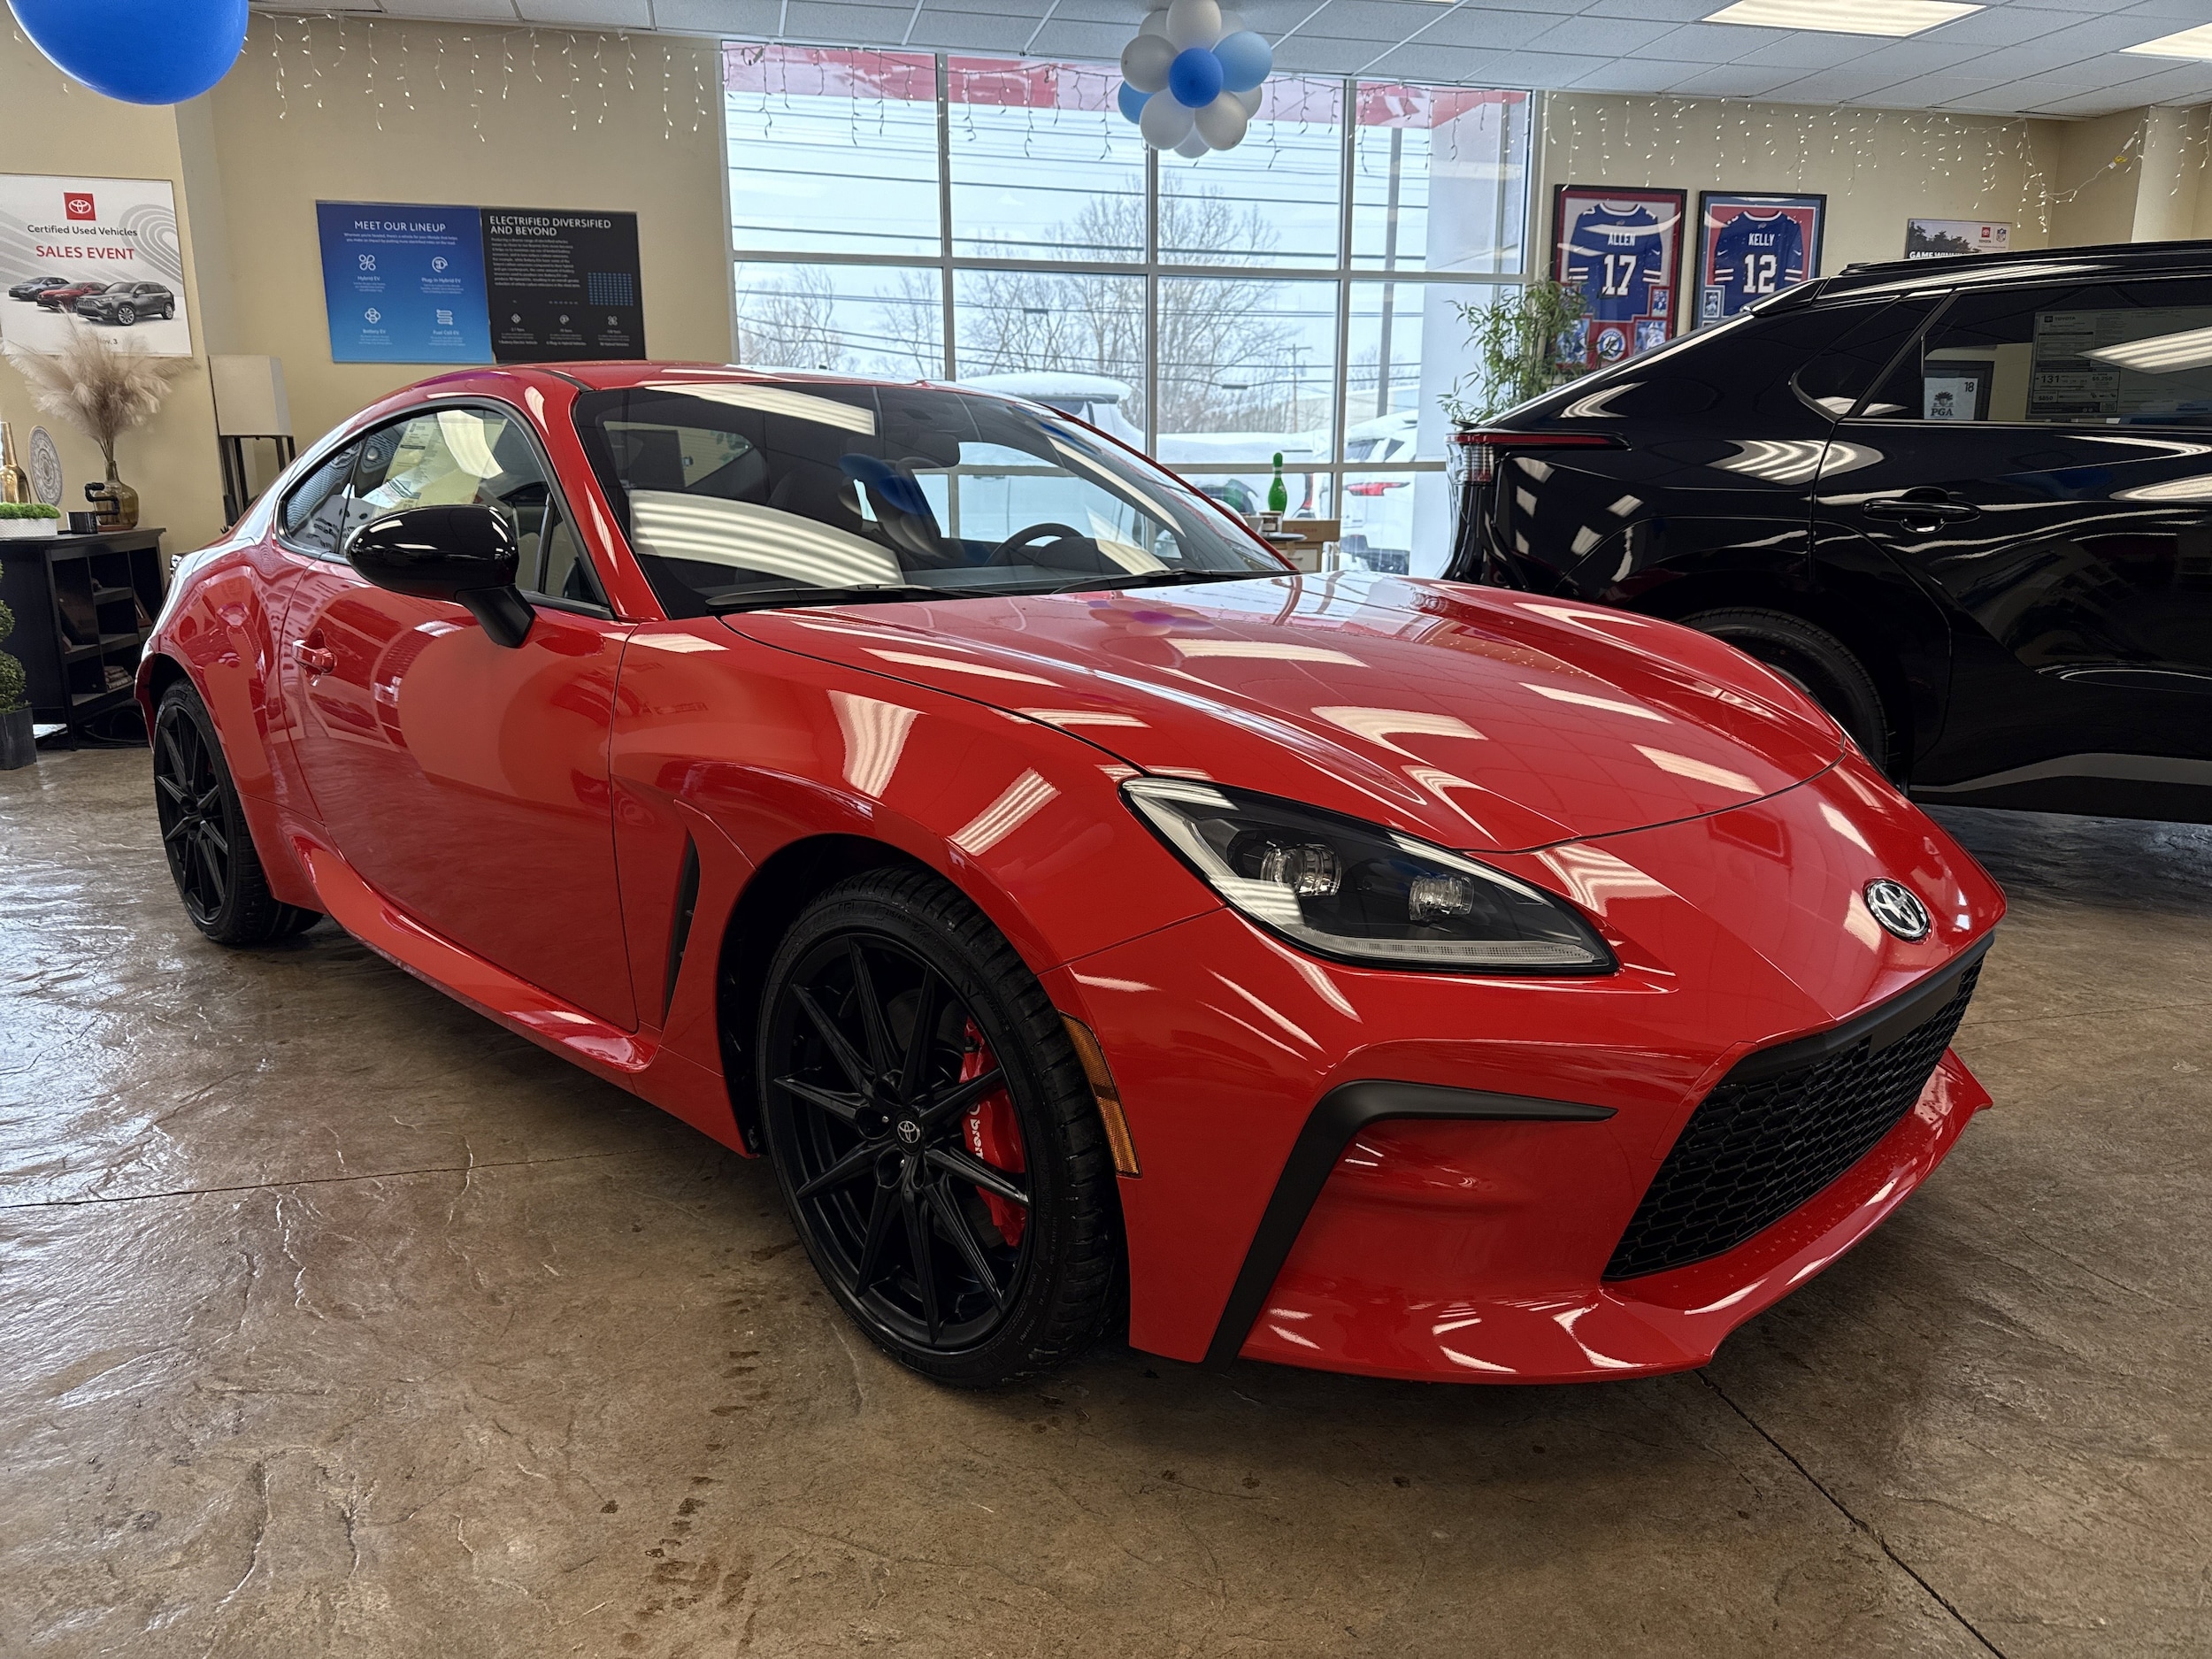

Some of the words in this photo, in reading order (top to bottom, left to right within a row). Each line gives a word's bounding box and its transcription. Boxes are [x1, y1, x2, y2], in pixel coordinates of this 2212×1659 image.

[354, 220, 380, 231] MEET
[384, 221, 407, 232] OUR
[410, 223, 446, 233] LINEUP
[490, 215, 550, 227] ELECTRIFIED
[552, 218, 611, 228] DIVERSIFIED
[27, 224, 70, 234] Certified
[73, 226, 96, 235] Used
[99, 227, 138, 237] Vehicles
[490, 227, 513, 235] AND
[515, 227, 557, 236] BEYOND
[1608, 232, 1636, 246] ALLEN
[1748, 233, 1775, 246] KELLY
[35, 245, 83, 258] SALES
[87, 247, 134, 260] EVENT
[1601, 254, 1637, 296] 17
[1743, 254, 1778, 294] 12
[2040, 375, 2060, 384] 131
[1964, 381, 1975, 393] 18
[970, 1118, 985, 1159] brem
